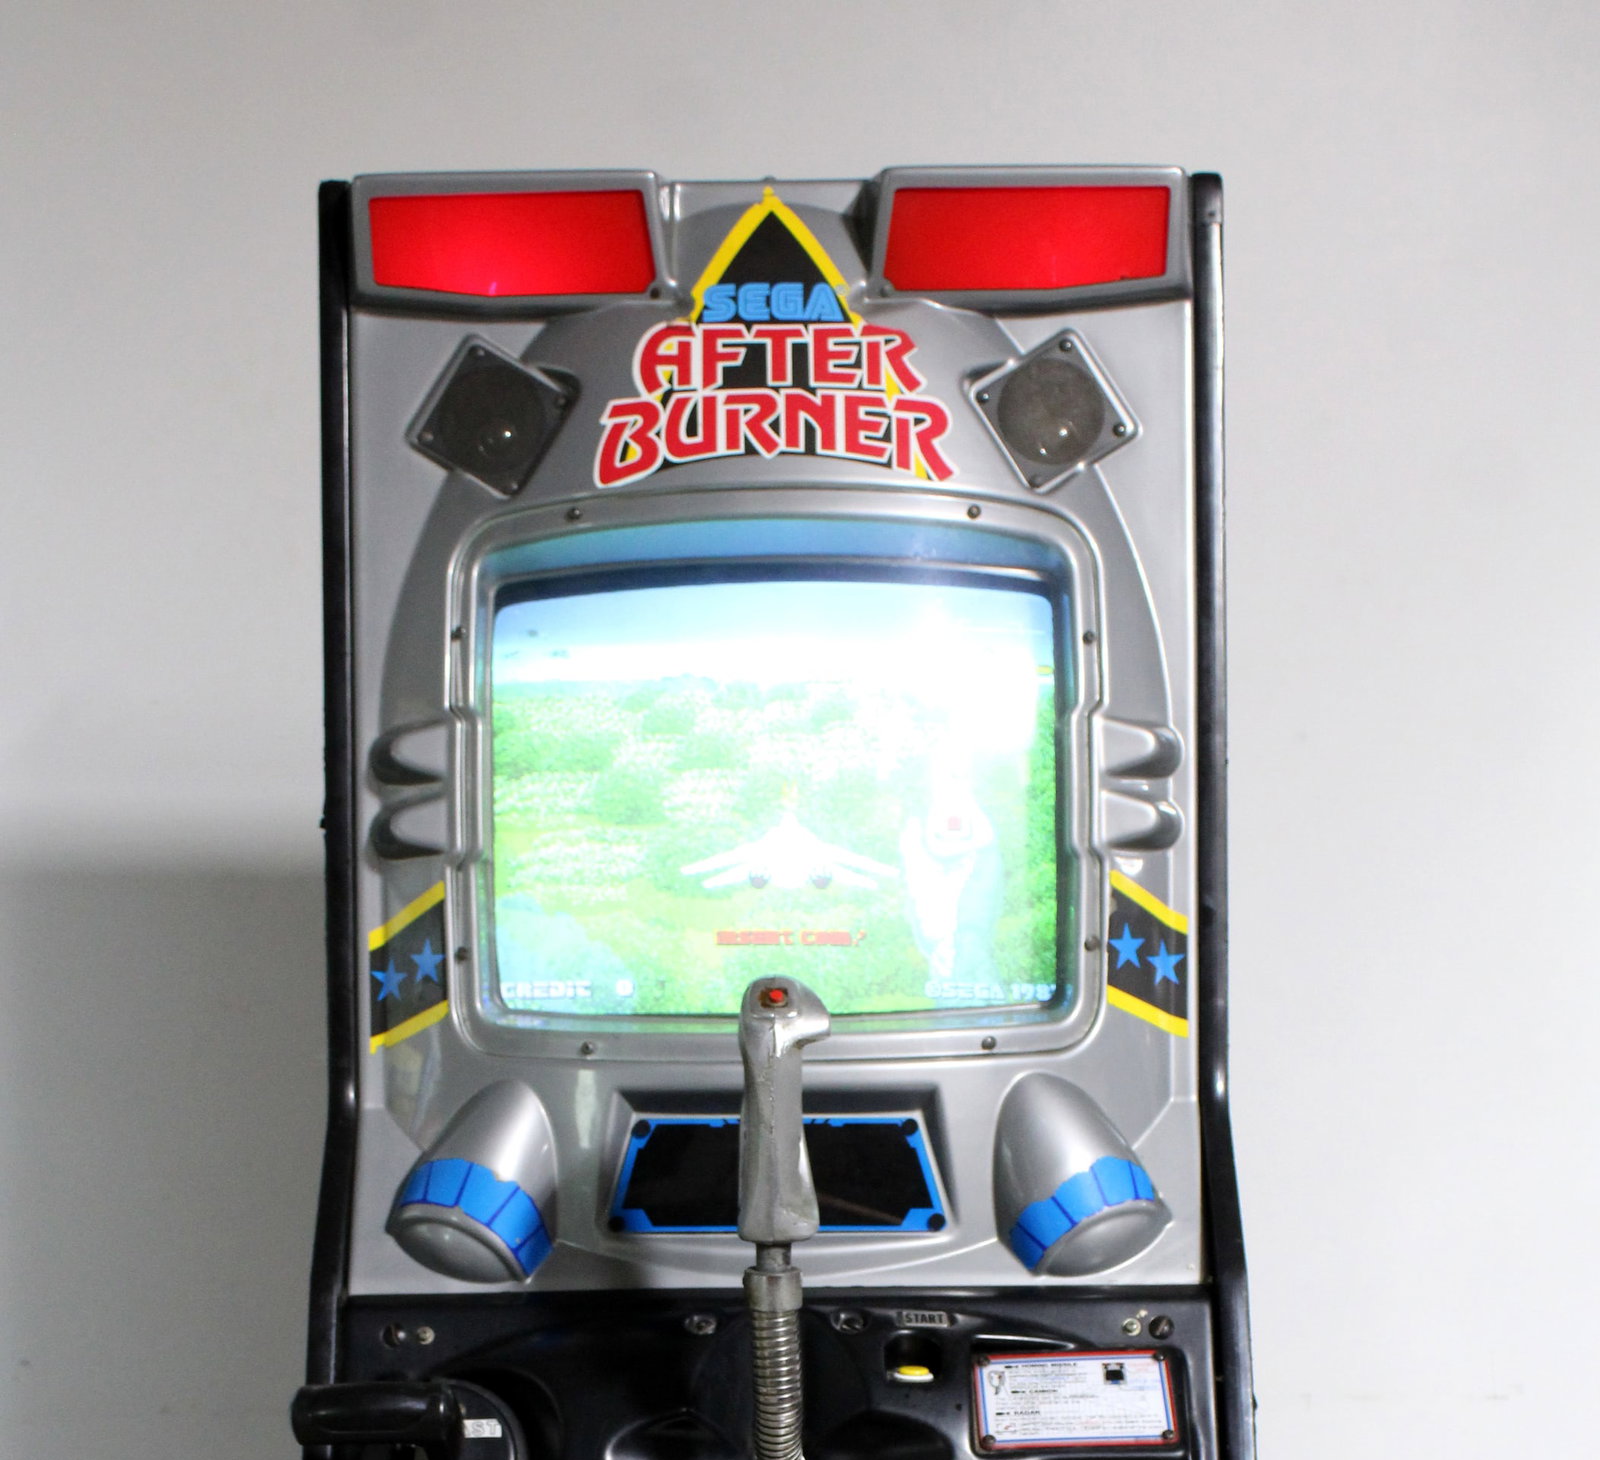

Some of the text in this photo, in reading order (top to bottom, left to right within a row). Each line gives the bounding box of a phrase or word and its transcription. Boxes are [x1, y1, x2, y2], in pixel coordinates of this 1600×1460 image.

[633, 321, 927, 397] AFTER
[594, 389, 959, 488] BURNER
[500, 980, 592, 999] CREDIT
[904, 1313, 944, 1324] START
